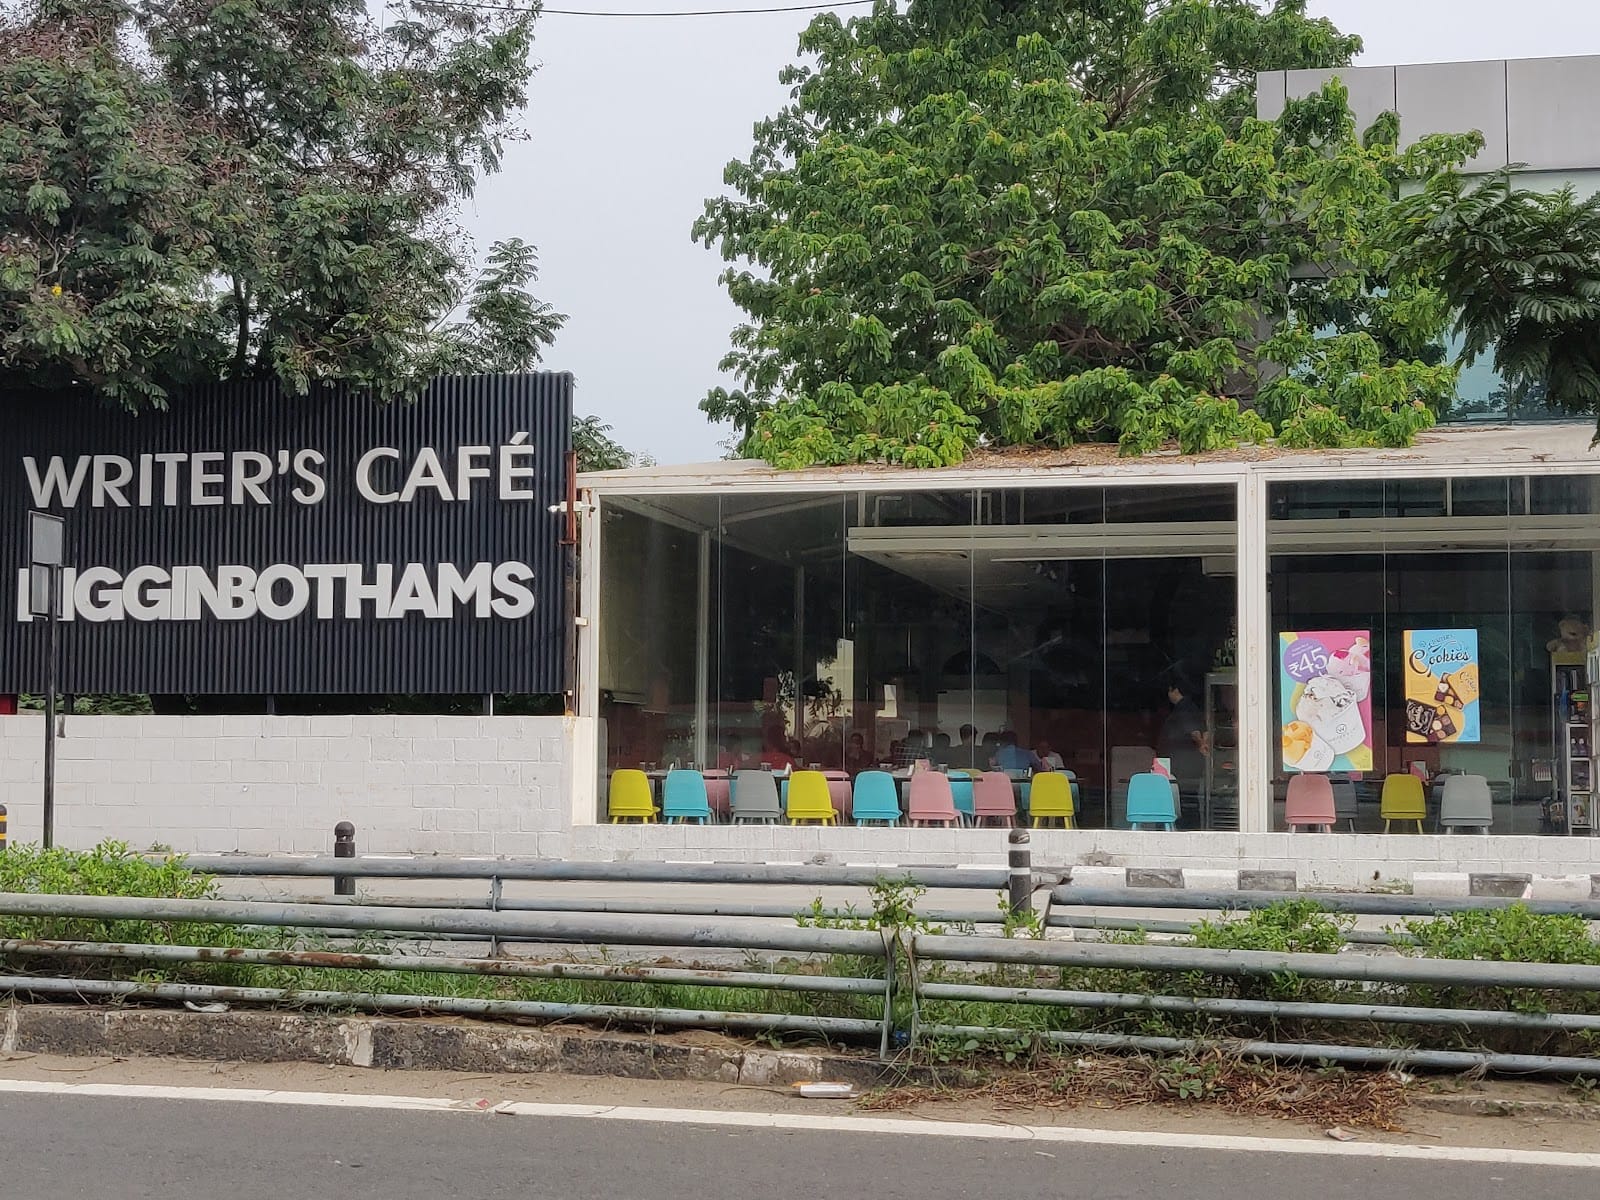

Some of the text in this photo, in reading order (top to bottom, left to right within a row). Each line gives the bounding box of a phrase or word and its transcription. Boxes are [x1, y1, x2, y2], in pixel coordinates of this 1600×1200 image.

[23, 432, 534, 508] WRITER'S CAFÉ
[1409, 648, 1470, 677] Cookies
